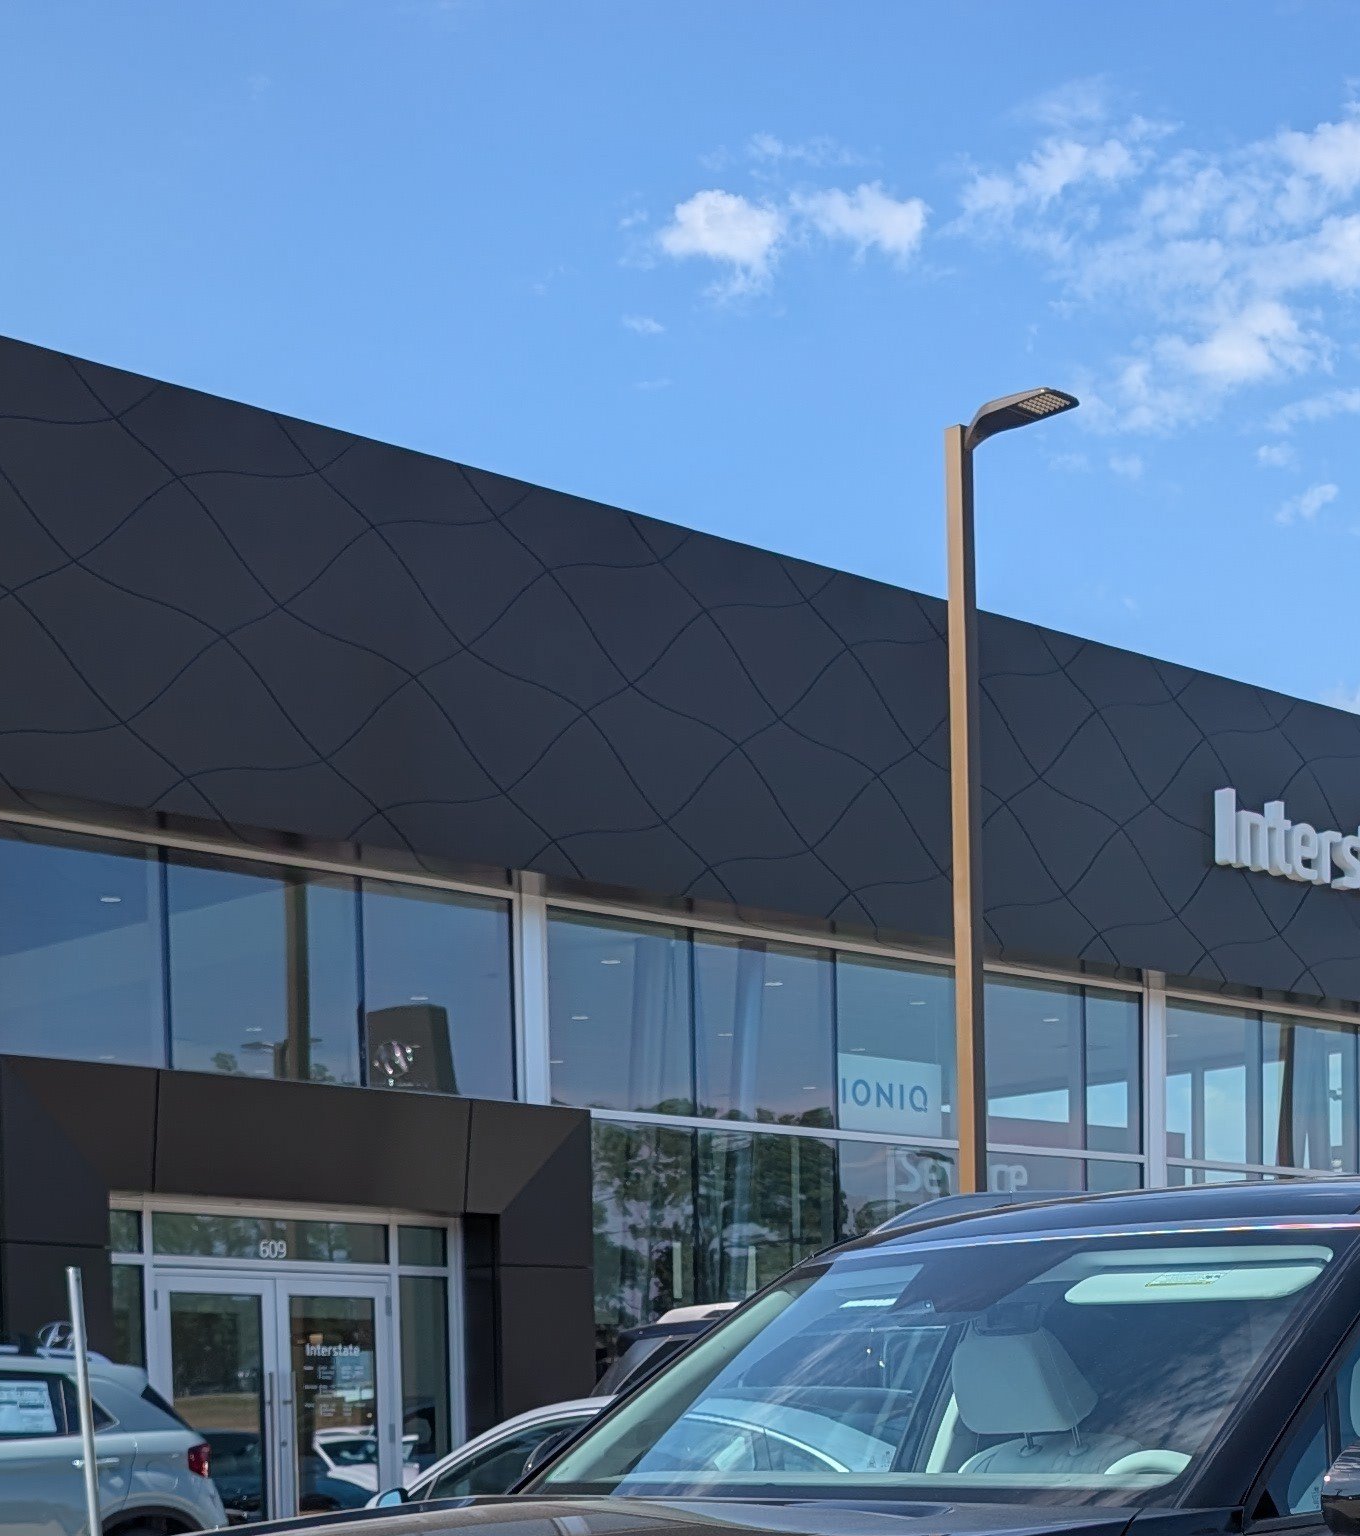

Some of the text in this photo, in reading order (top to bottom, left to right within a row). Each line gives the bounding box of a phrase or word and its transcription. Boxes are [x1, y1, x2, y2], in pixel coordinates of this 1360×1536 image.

[841, 1077, 928, 1113] IONIQ
[259, 1238, 288, 1259] 609
[305, 1342, 361, 1357] Interstate
